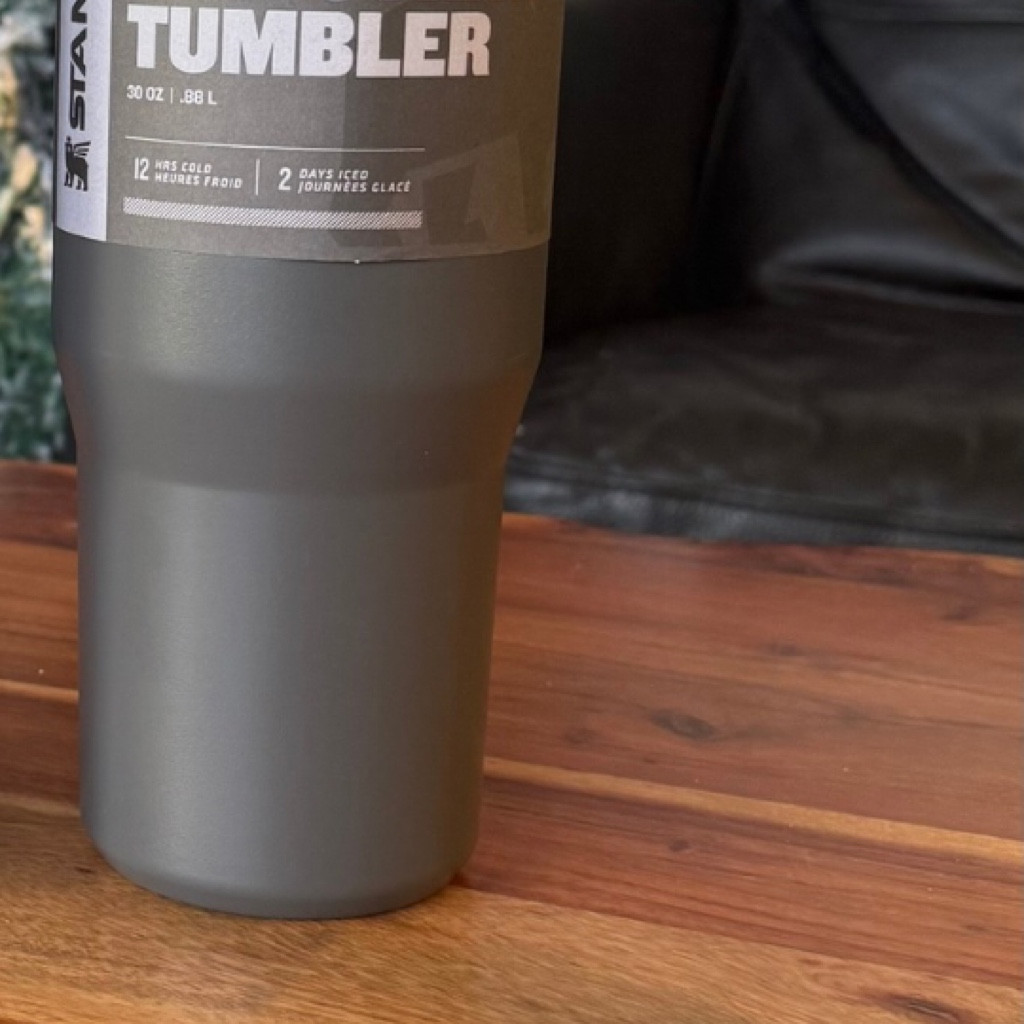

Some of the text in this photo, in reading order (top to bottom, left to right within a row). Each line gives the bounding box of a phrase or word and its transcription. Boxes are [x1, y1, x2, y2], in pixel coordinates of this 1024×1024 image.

[127, 4, 492, 78] TUMBLER
[126, 85, 143, 101] 30
[145, 87, 164, 101] OZ
[208, 90, 218, 105] L
[134, 158, 212, 180] 12 HRS COLD
[155, 172, 243, 188] HEURES FROID
[279, 167, 292, 190] 2
[298, 168, 334, 180] DAYS
